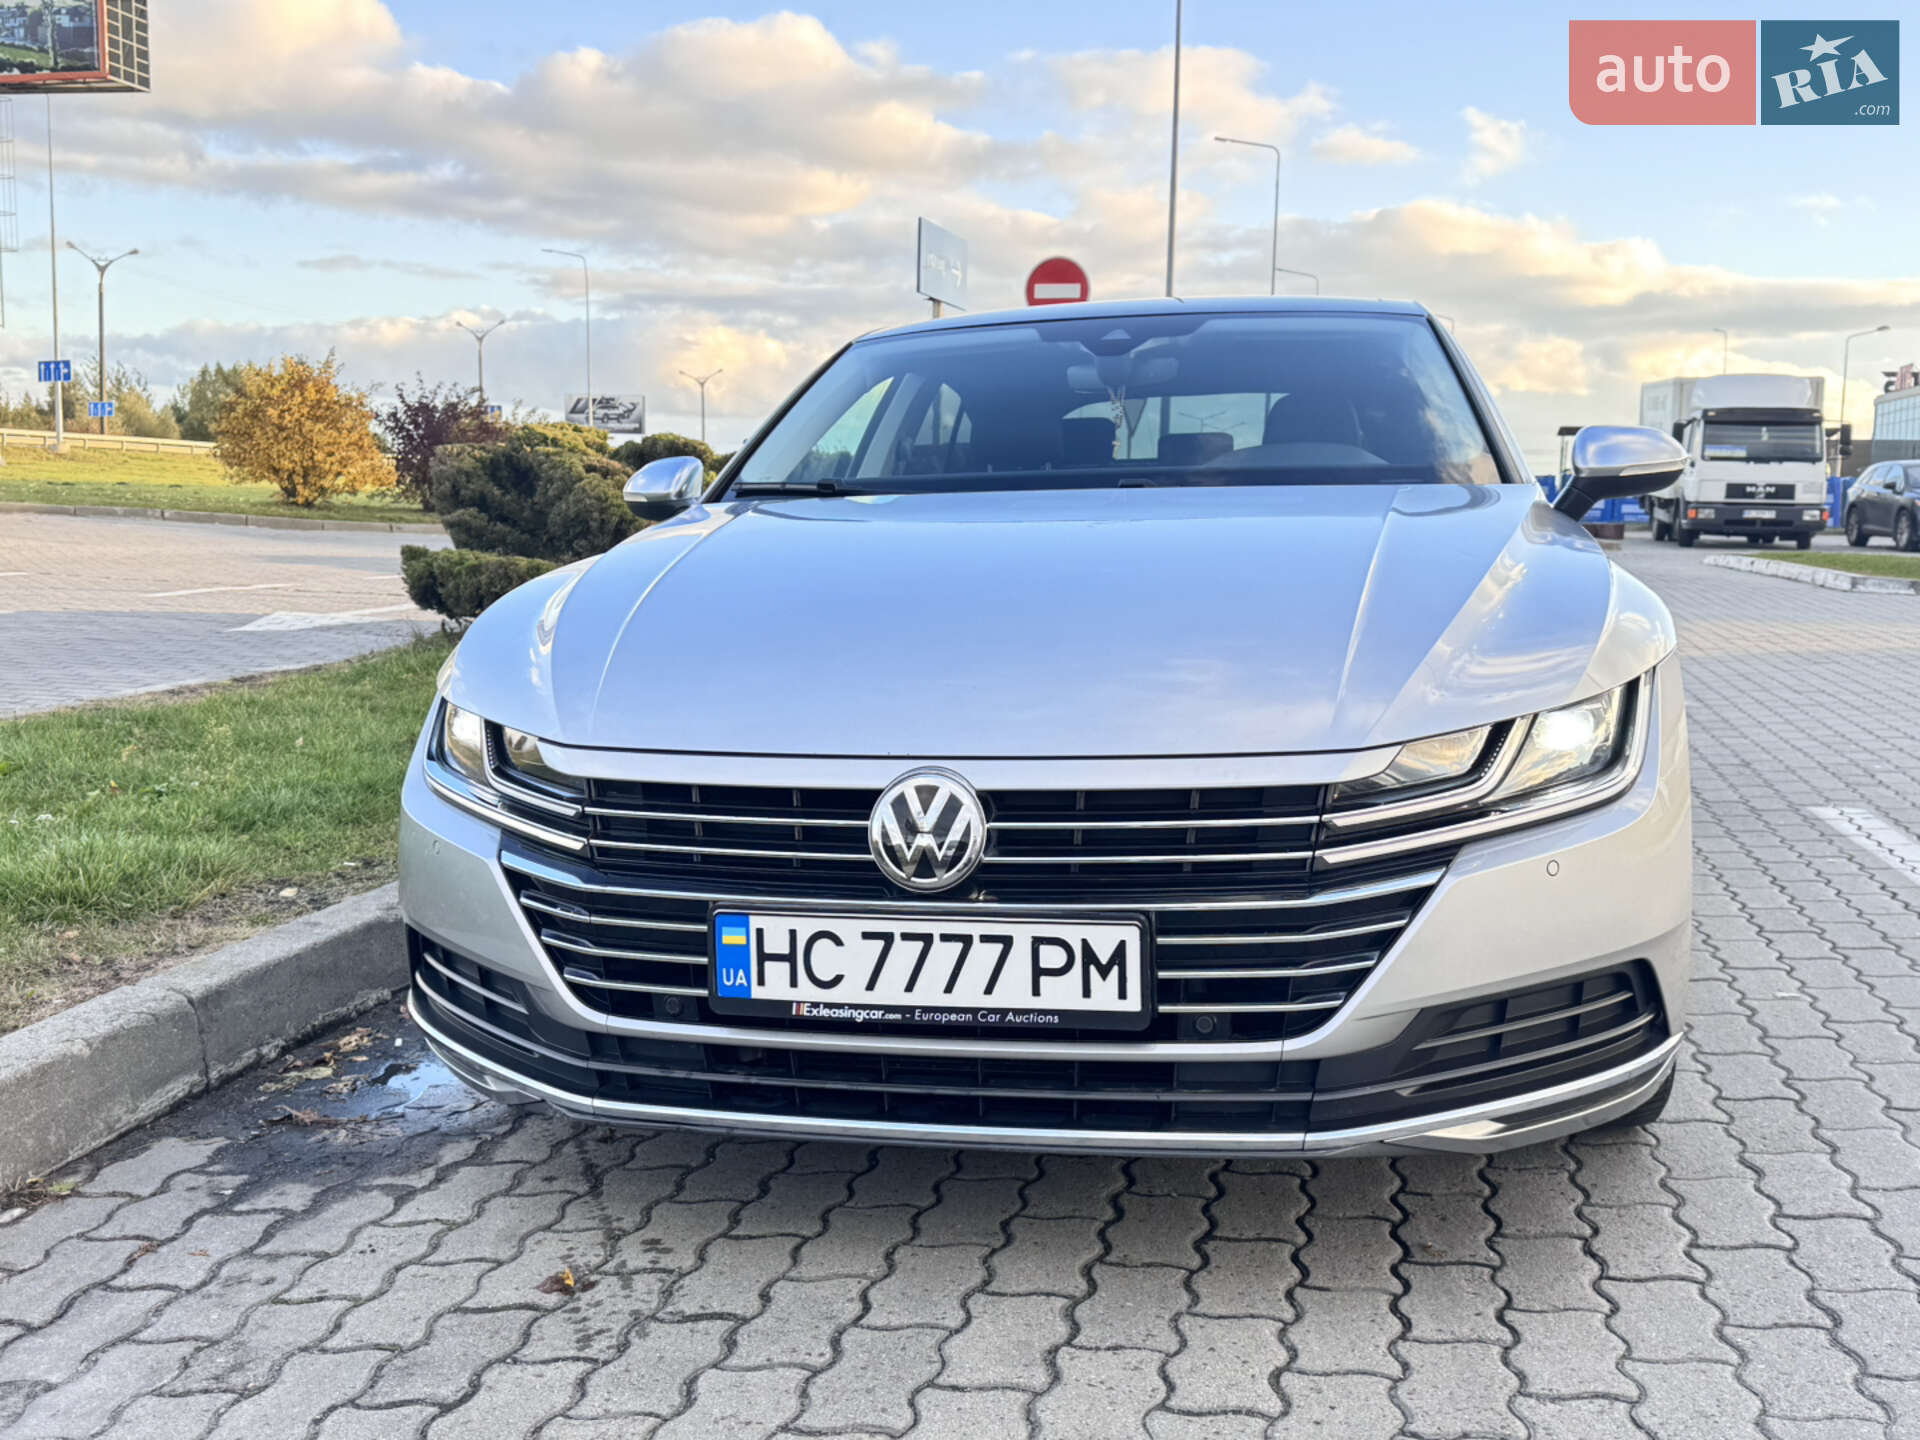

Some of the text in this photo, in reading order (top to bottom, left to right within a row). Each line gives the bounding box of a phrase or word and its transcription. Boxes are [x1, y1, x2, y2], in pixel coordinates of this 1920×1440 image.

[755, 927, 1128, 1001] HC 7777 PM
[722, 967, 748, 987] UA
[804, 1003, 902, 1023] Exleasingcar.com
[914, 1010, 973, 1024] European
[977, 1011, 1001, 1023] Car
[1005, 1012, 1059, 1024] Auctions
